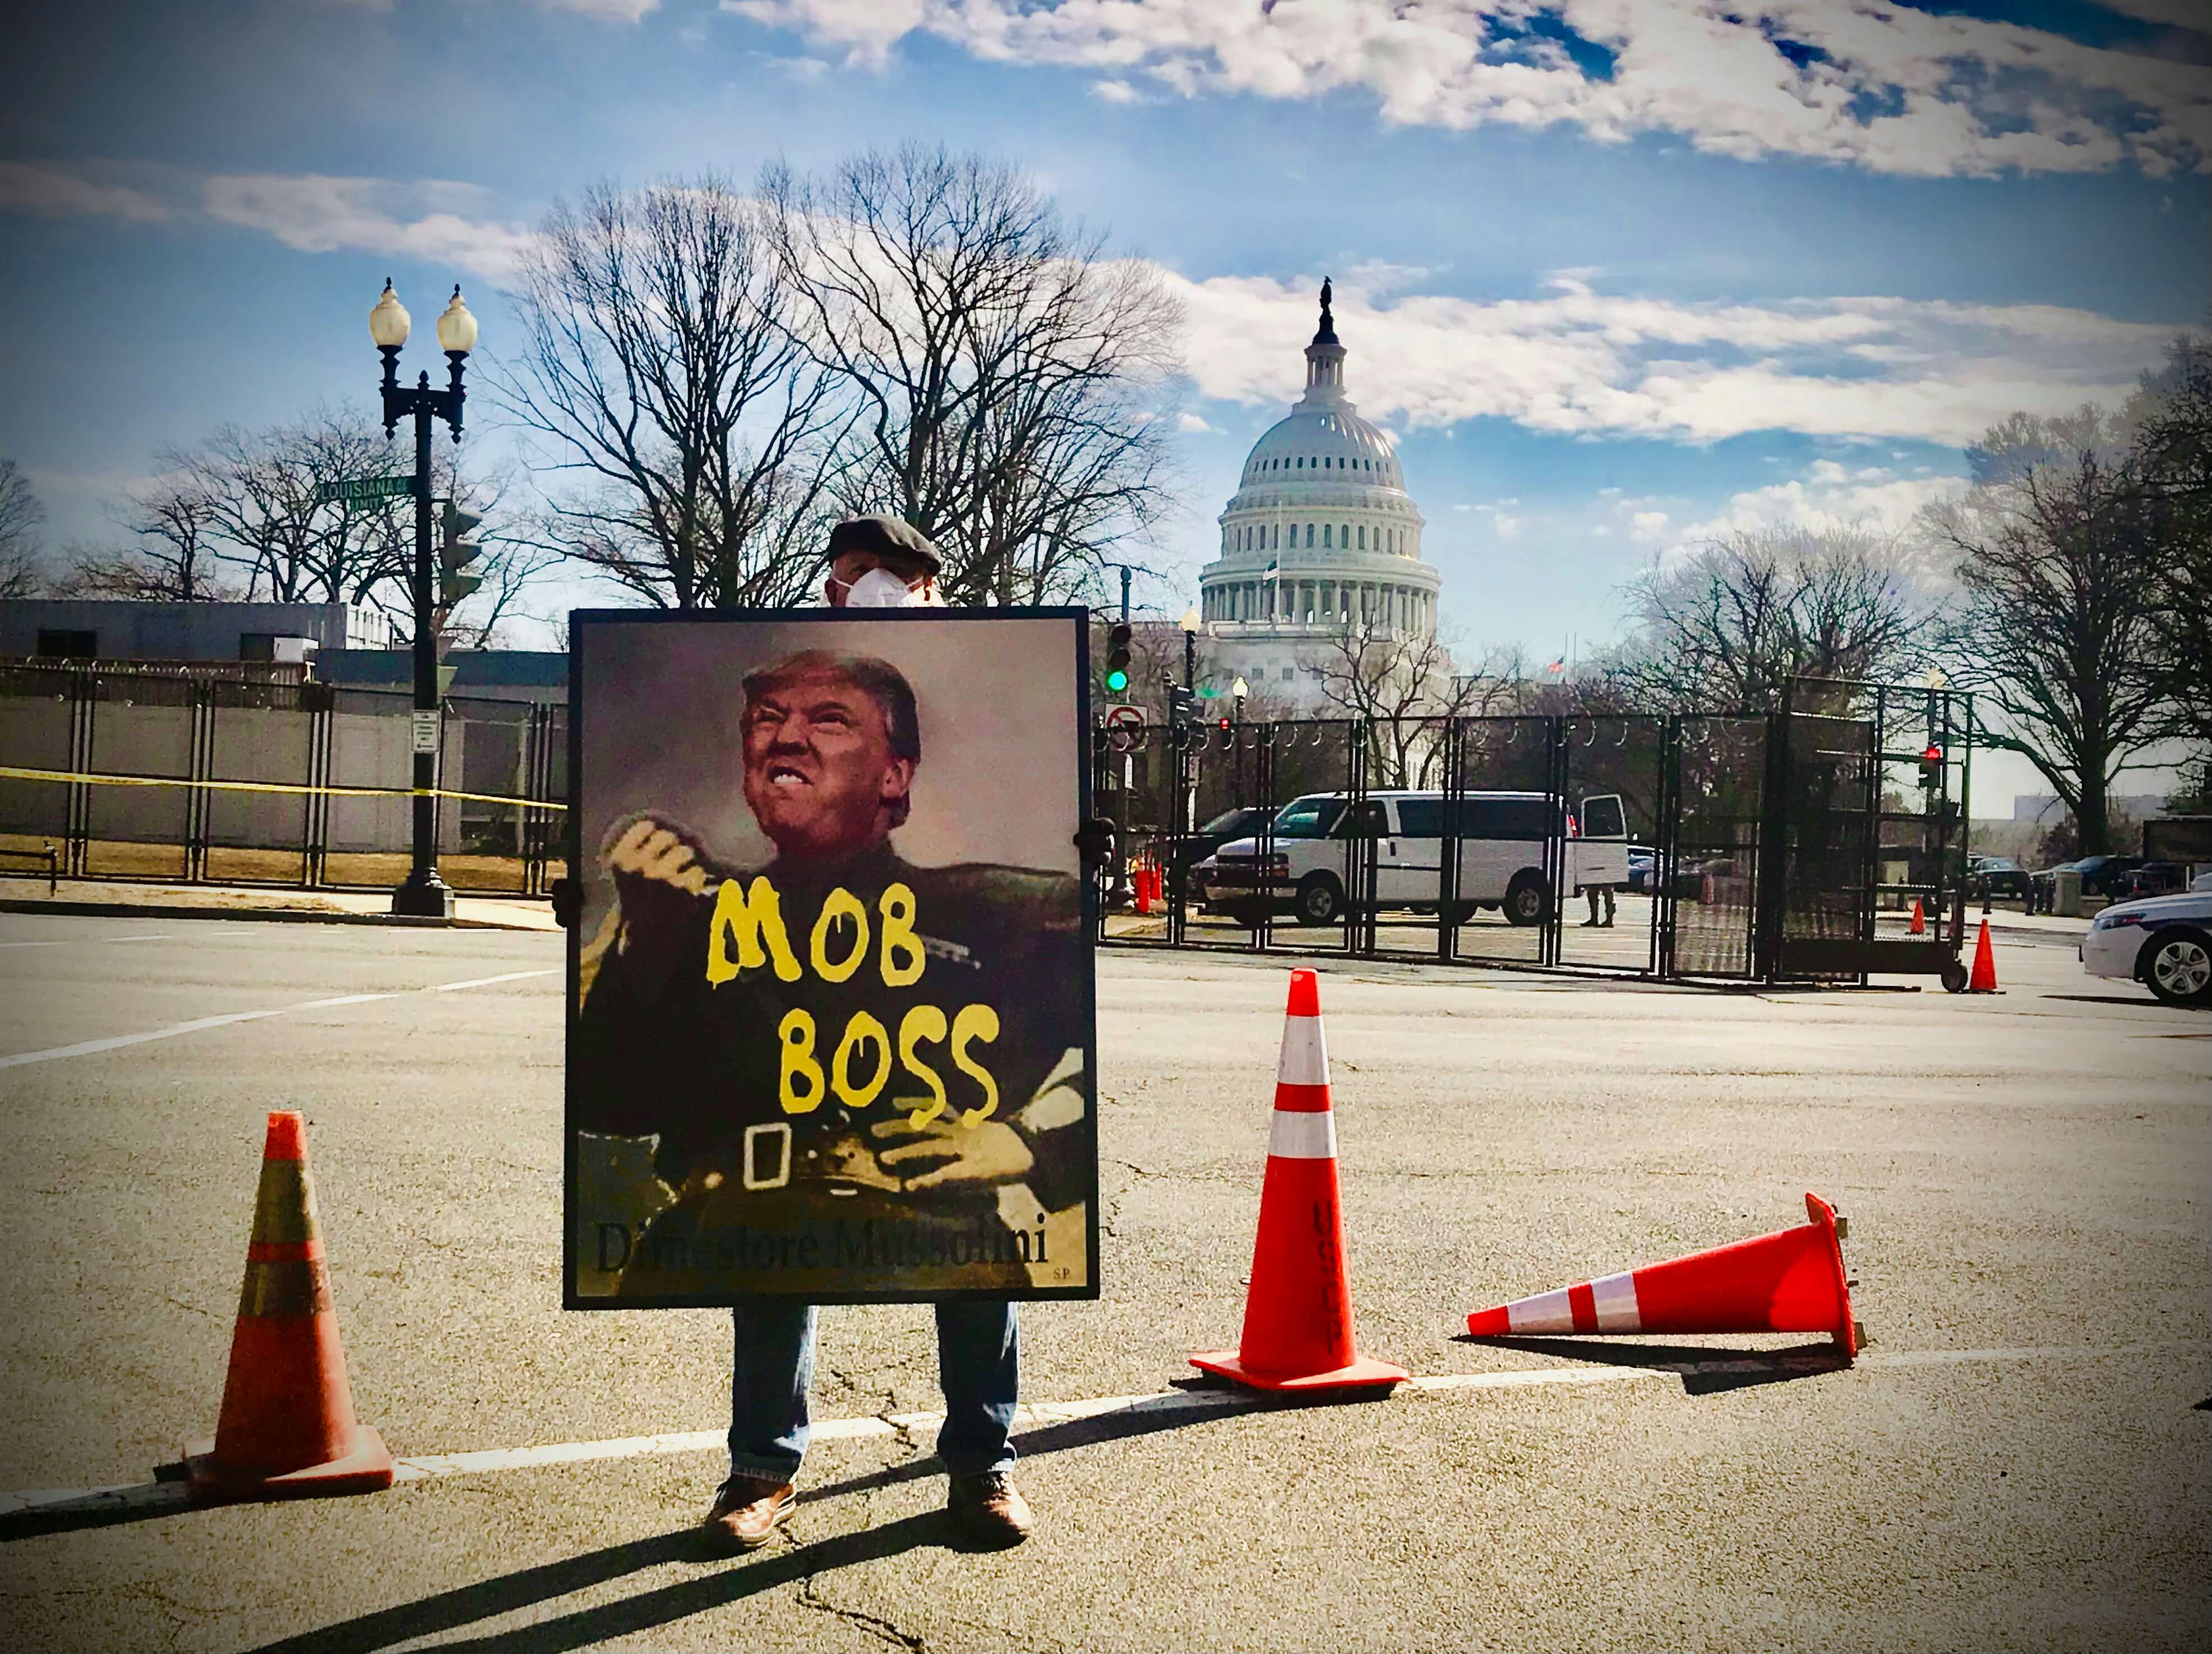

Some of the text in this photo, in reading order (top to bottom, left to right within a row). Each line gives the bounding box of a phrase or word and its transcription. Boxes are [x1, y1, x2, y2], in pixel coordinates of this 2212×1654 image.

[321, 480, 394, 500] LOUISIANA
[706, 876, 926, 990] MOB
[778, 1003, 1000, 1131] BOSS
[597, 1213, 1049, 1271] Dimestore Mussolini
